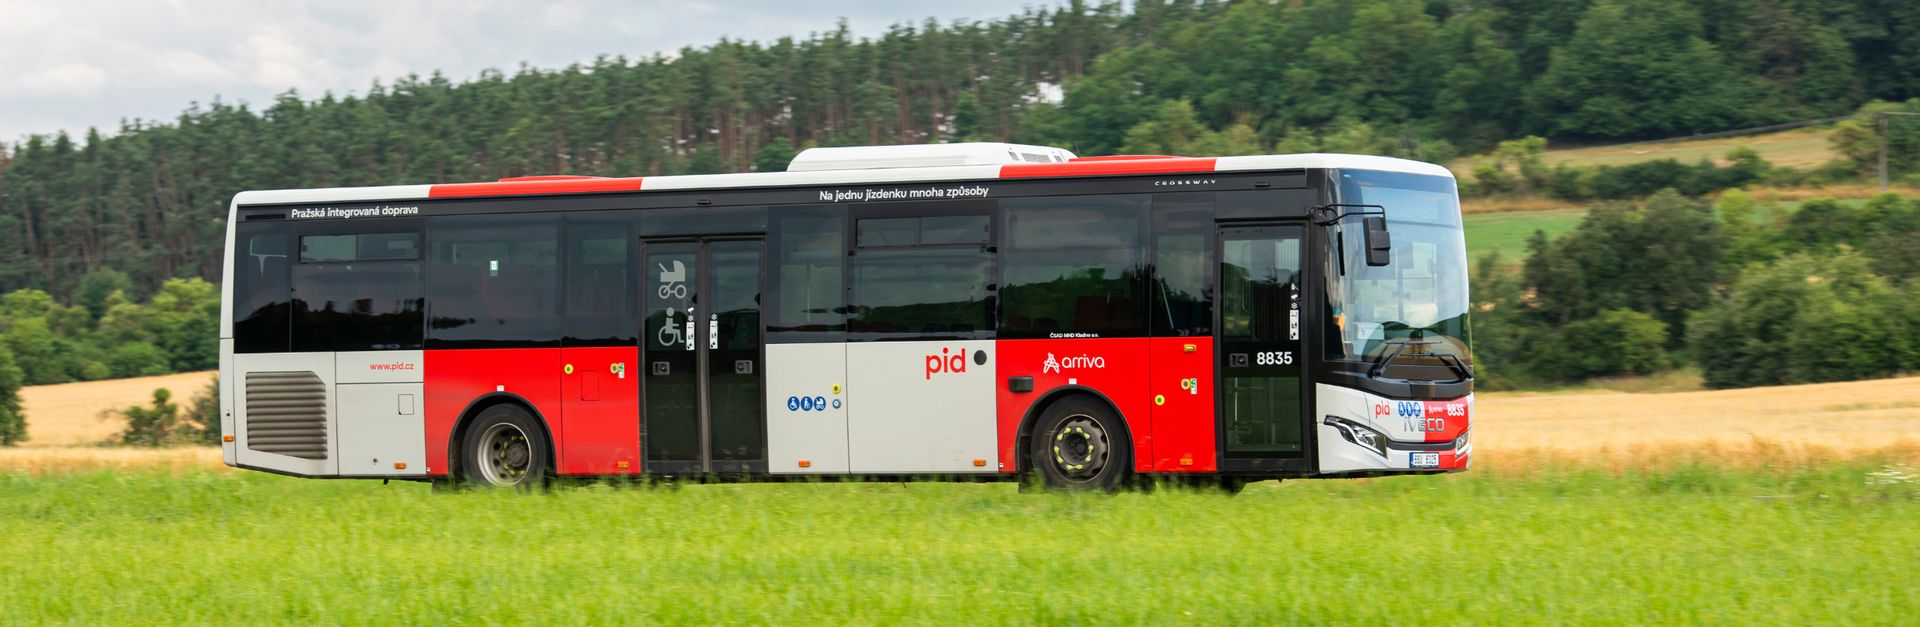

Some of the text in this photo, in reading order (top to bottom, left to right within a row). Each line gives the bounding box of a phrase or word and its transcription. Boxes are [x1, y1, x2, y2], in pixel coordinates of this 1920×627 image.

[819, 185, 989, 202] Na jednu jízdenku mnoha způsoby
[291, 205, 419, 219] Pražská integrovaná doprava
[369, 361, 415, 372] www.pid.cz
[925, 346, 966, 380] pid
[1061, 353, 1105, 369] arriva
[1256, 351, 1293, 366] 8835
[1375, 400, 1391, 419] pid
[1446, 403, 1465, 417] 8835
[1403, 416, 1445, 432] IVECO
